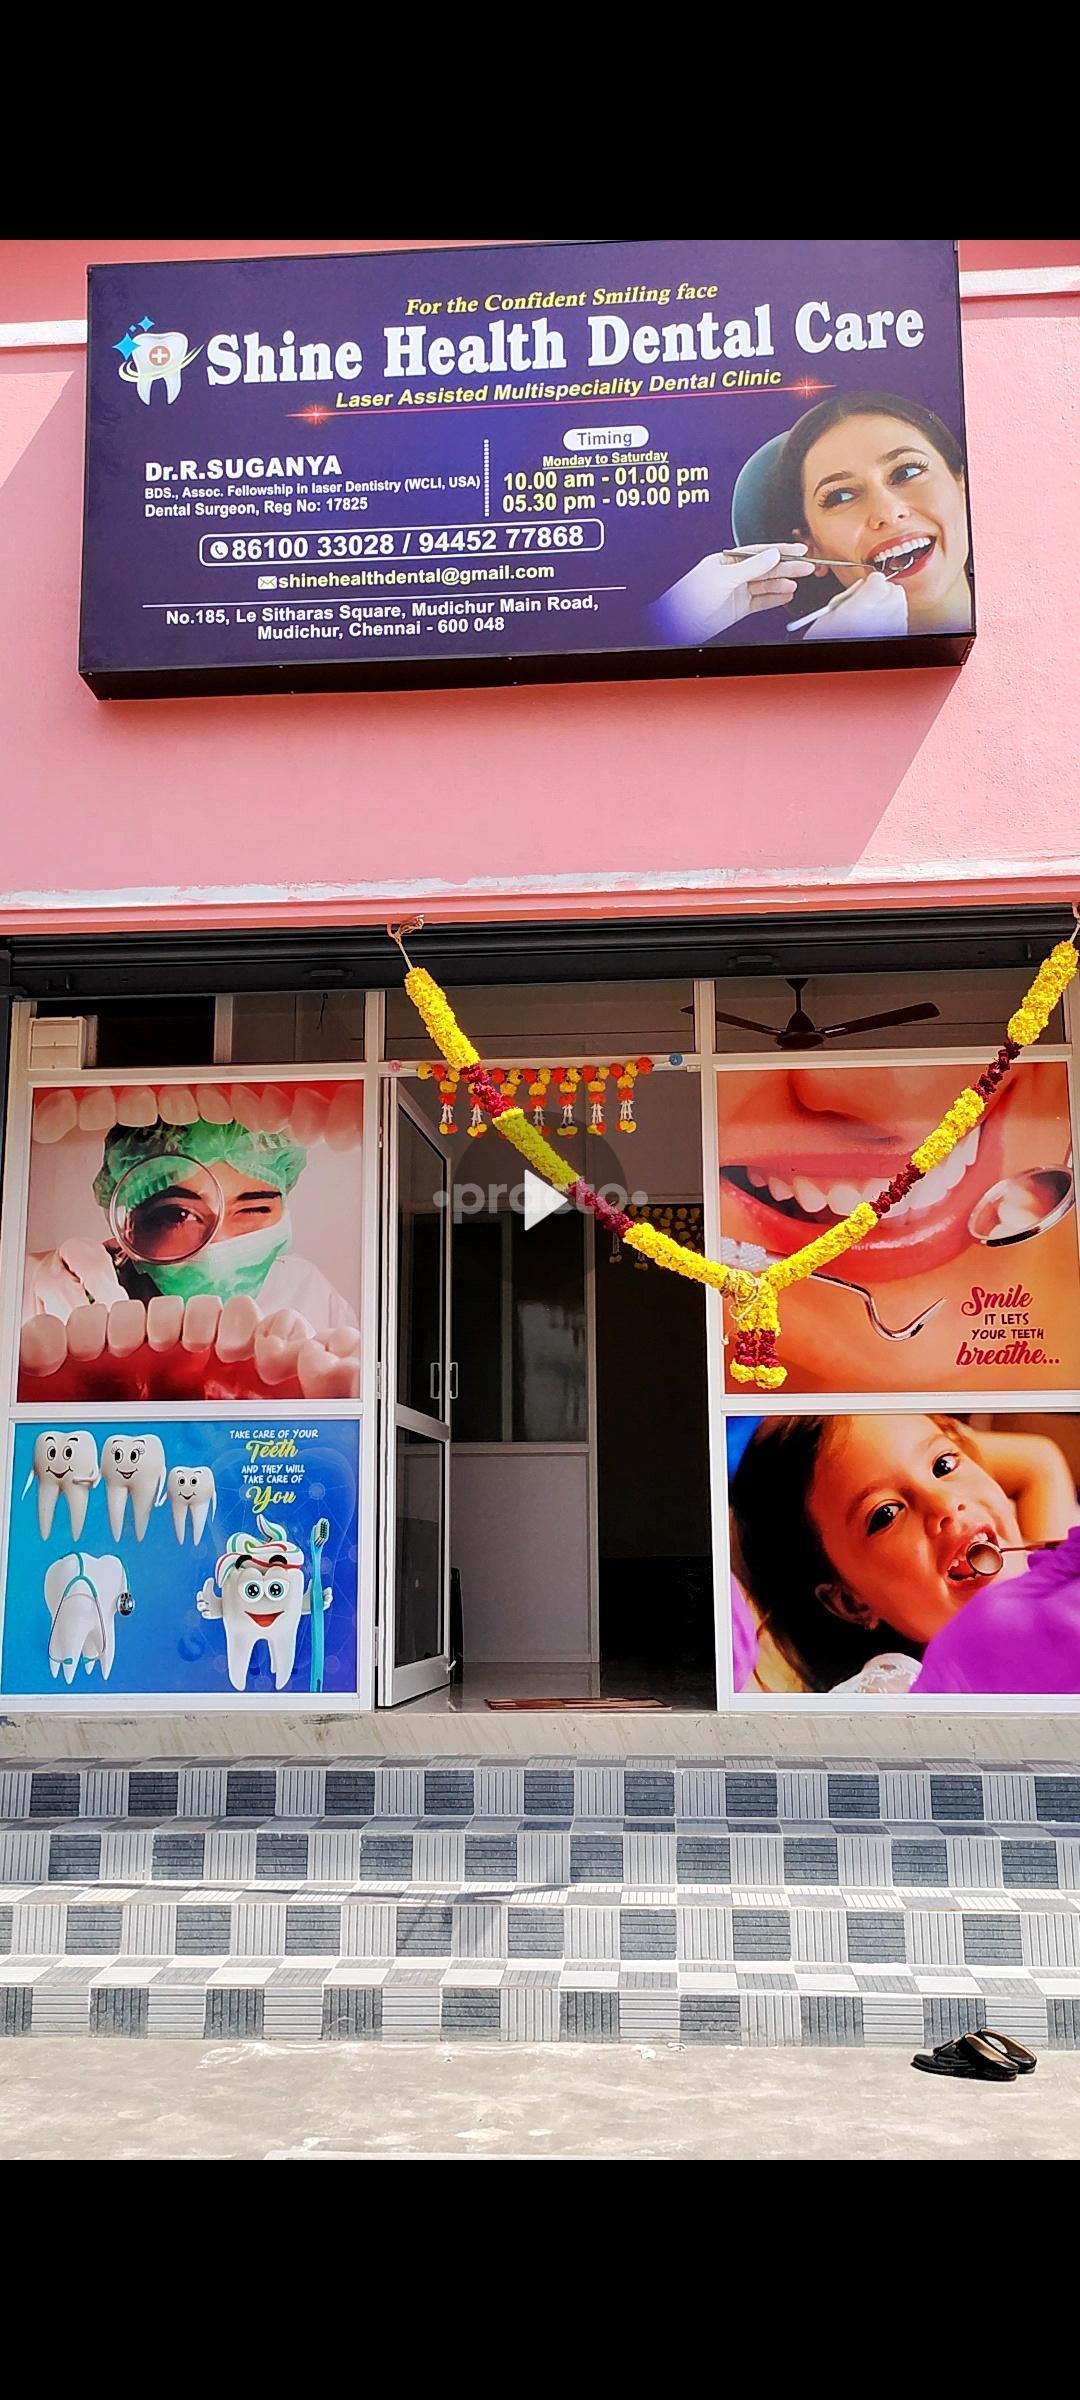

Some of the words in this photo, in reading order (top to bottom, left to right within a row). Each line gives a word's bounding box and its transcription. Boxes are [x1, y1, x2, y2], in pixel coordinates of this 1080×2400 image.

[405, 298, 441, 316] For
[447, 296, 478, 313] the
[485, 290, 586, 311] Confident
[592, 286, 670, 307] Smiling
[676, 283, 718, 302] face
[206, 330, 363, 386] Shine
[383, 316, 567, 377] Health
[587, 304, 774, 367] Dental
[795, 301, 924, 353] Care
[336, 391, 392, 409] Laser
[398, 385, 487, 406] Assisted
[494, 377, 643, 402] Multispeciality
[649, 374, 715, 393] Dental
[722, 369, 781, 387] Clinic
[577, 431, 632, 447] Timing
[145, 455, 342, 482] Dr.R.SUGANYA
[543, 454, 592, 468] Monday
[595, 453, 608, 465] to
[611, 451, 668, 465] Saturday
[145, 487, 179, 500] BDS.,
[182, 486, 223, 499] Assoc.
[227, 483, 293, 498] Fellowship
[296, 483, 308, 494] in
[311, 482, 342, 494] laser
[345, 479, 401, 494] Dentistry
[404, 477, 445, 493] (WCLI,
[449, 475, 481, 490] USA)
[503, 472, 557, 491] 10.00
[564, 474, 595, 488] am
[614, 466, 670, 485] 01.00
[676, 466, 709, 485] pm
[145, 503, 191, 518] Dental
[195, 502, 259, 518] Surgeon,
[264, 501, 292, 516] Reg
[297, 500, 321, 514] No:
[327, 497, 368, 511] 17825
[502, 494, 557, 512] 05.30
[564, 494, 596, 514] pm
[615, 487, 671, 507] 09.00
[678, 488, 710, 507] pm
[232, 537, 309, 560] 86100
[317, 534, 394, 557] 33028
[402, 533, 410, 554] /
[419, 530, 497, 553] 94452
[506, 526, 584, 549] 77868
[279, 564, 554, 589] shinehealthdental@gmail.com
[166, 609, 230, 626] No.185,
[236, 609, 256, 623] Le
[261, 606, 334, 622] Sitharas
[339, 604, 406, 621] Square,
[412, 600, 494, 617] Mudichur
[500, 598, 542, 612] Main
[547, 594, 599, 612] Road,
[258, 623, 344, 641] Mudichur,
[349, 620, 421, 637] Chennai
[437, 619, 469, 634] 600
[473, 617, 505, 632] 048
[961, 1284, 1033, 1316] Smile
[984, 1314, 996, 1325] IT
[1001, 1313, 1029, 1325] LETS
[971, 1329, 1007, 1340] YOUR
[1011, 1328, 1044, 1339] TEETH
[956, 1340, 1060, 1366] breathe...
[229, 1430, 250, 1439] TAKE
[253, 1430, 275, 1439] CARE
[278, 1430, 290, 1438] OF
[292, 1429, 319, 1438] YOUR
[245, 1439, 298, 1463] Teeth
[241, 1465, 258, 1474] AND
[262, 1464, 283, 1474] THEY
[286, 1464, 305, 1473] WILL
[243, 1475, 263, 1484] TAKE
[266, 1475, 288, 1483] CARE
[291, 1475, 303, 1483] OF
[245, 1485, 297, 1514] You
